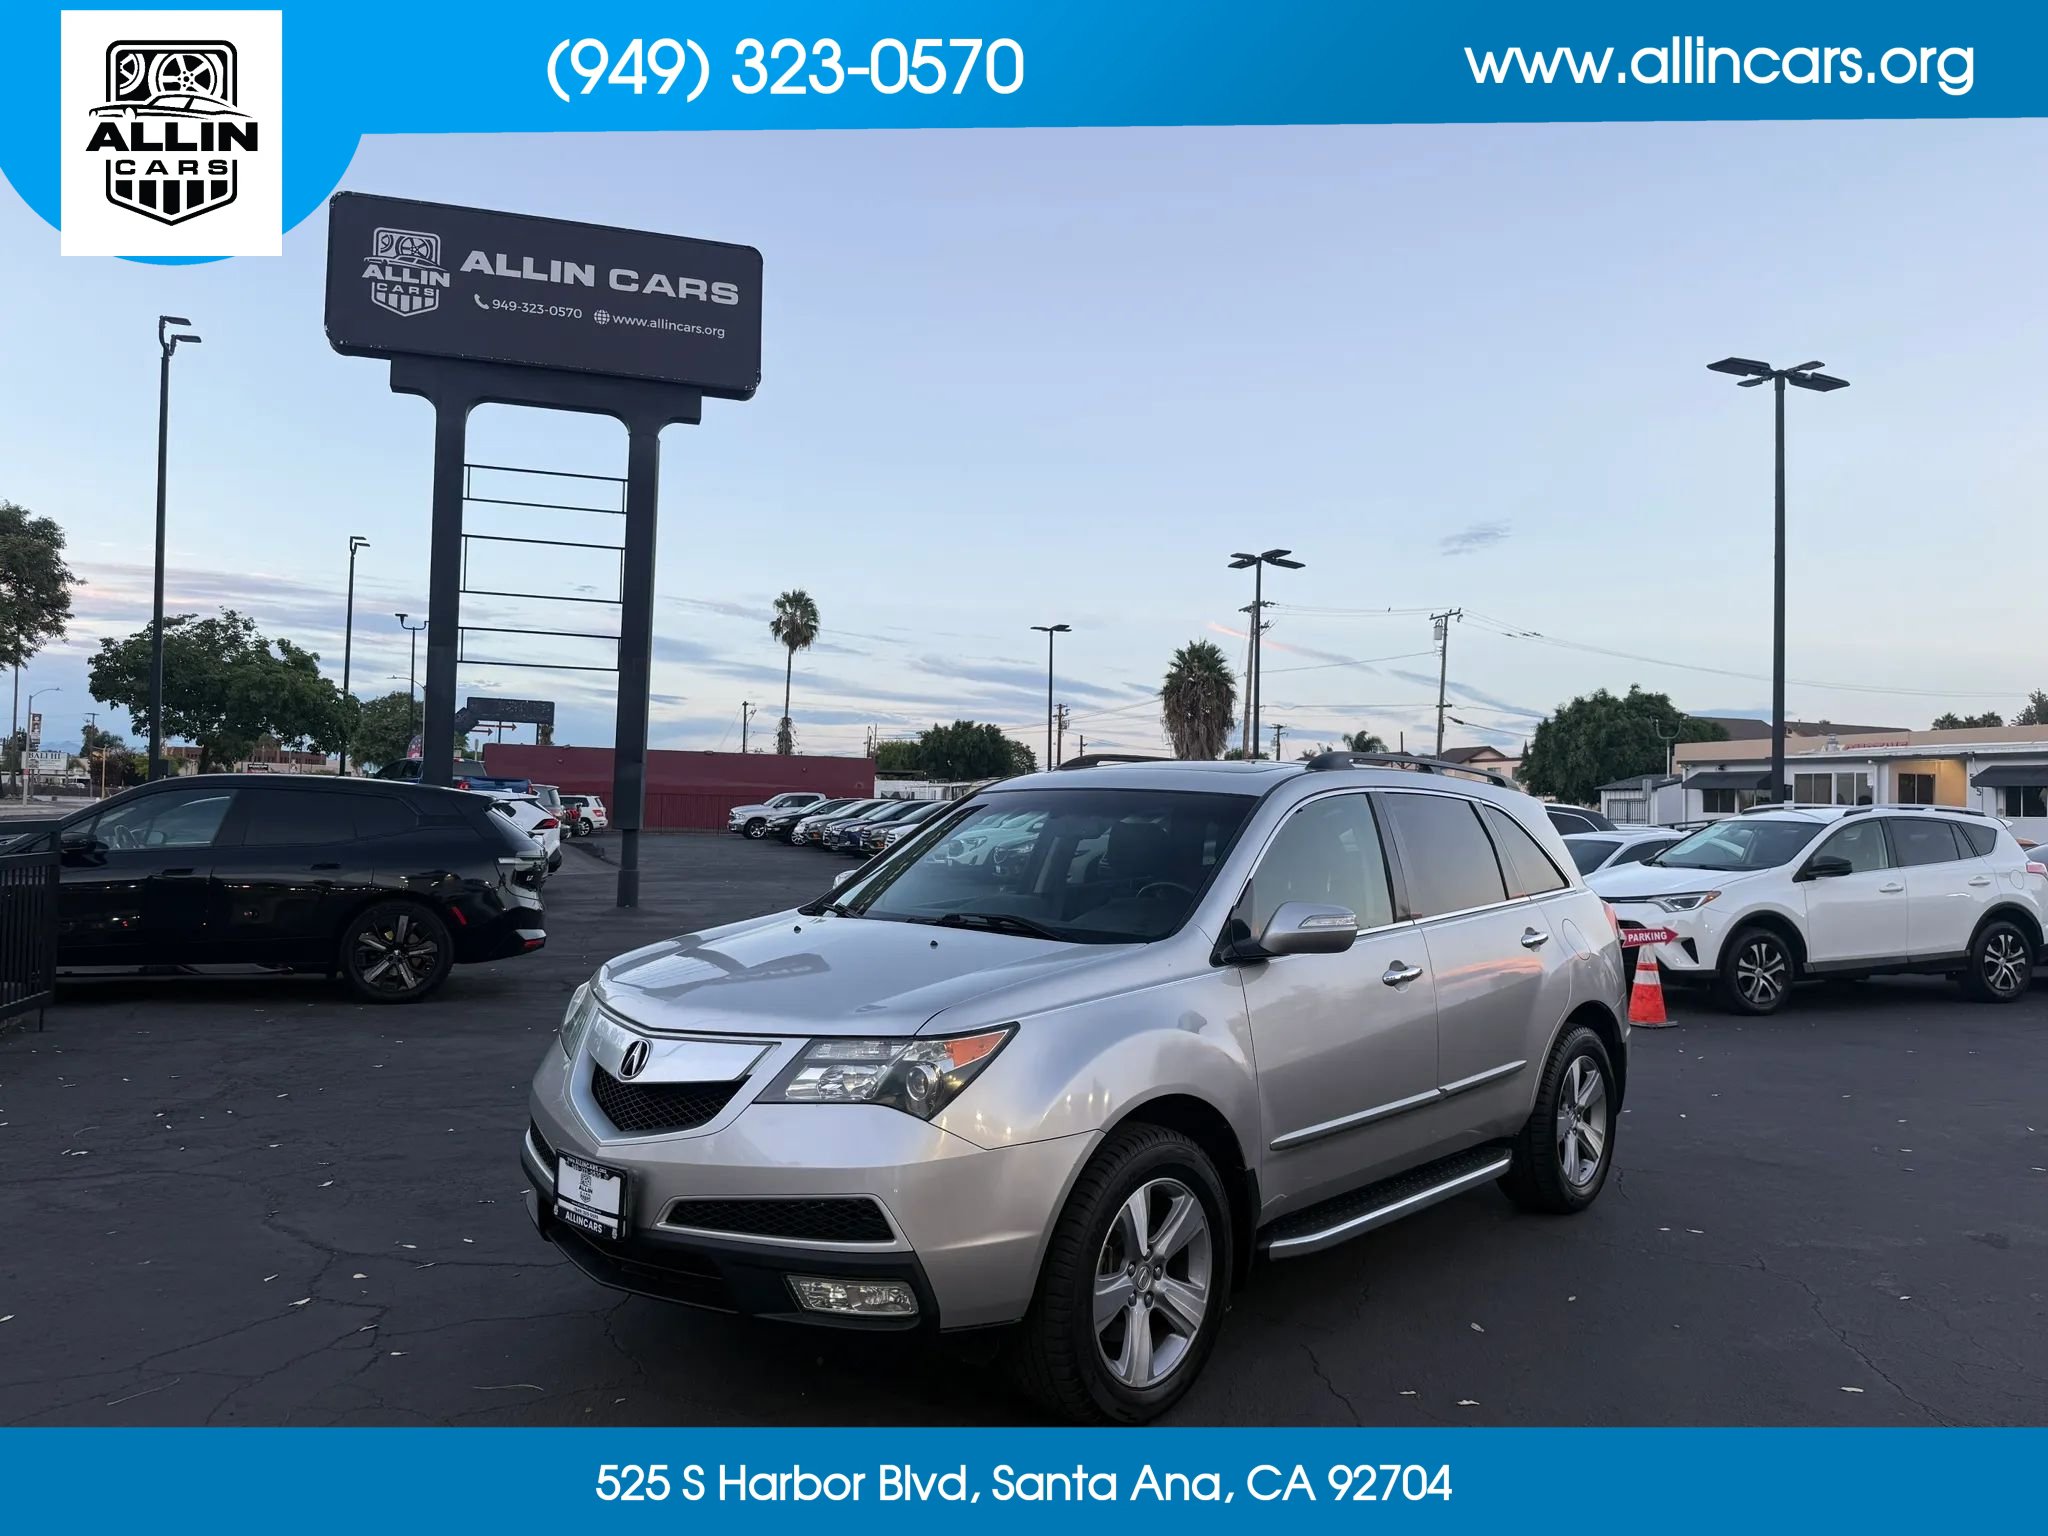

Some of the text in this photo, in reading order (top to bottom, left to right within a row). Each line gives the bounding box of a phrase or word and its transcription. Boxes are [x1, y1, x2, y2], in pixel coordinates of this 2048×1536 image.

[361, 264, 451, 288] ALLIN
[459, 250, 740, 306] ALLIN CARS
[376, 283, 435, 297] CARS
[491, 298, 584, 320] 949-323-0570
[612, 314, 726, 339] www.allincars.org
[1627, 931, 1668, 942] PARKING
[565, 1211, 603, 1234] ALLINCARS
